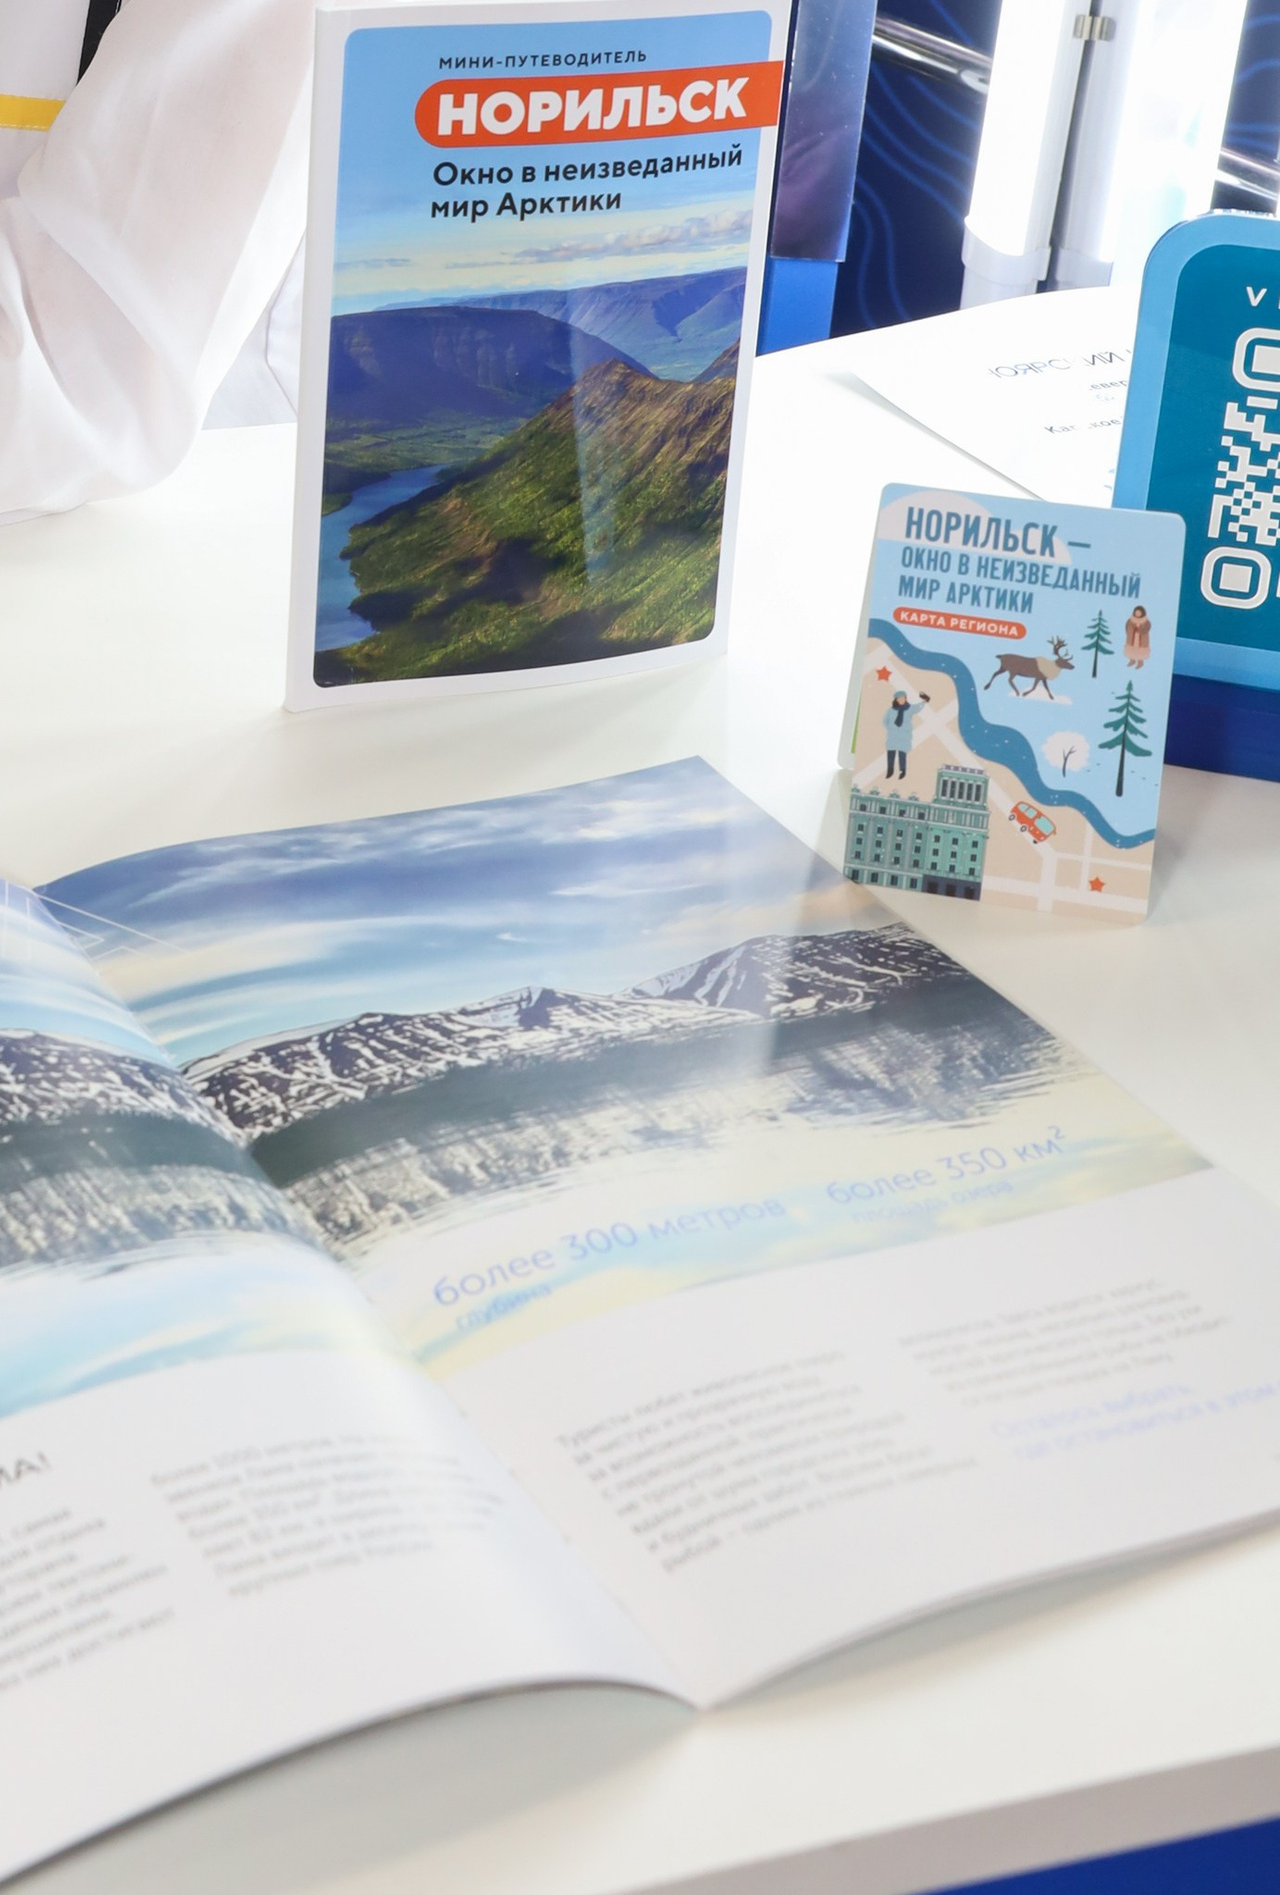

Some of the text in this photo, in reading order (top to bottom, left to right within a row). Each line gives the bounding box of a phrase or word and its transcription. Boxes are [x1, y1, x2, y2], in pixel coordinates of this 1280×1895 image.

[438, 50, 648, 70] МИНИ-ПУТЕВОДИТЕЛЬ
[437, 76, 750, 136] НОРИЛЬСК
[432, 143, 743, 187] Окно в неизведанный
[430, 190, 622, 224] мир Арктики
[904, 506, 1058, 559] НОРИЛЬСК
[897, 575, 1035, 615] МИР АРКТИКИ
[901, 546, 1142, 600] ОКНО В НЕИЗВЕДАННЫЙ
[899, 611, 1020, 638] КАРТА РЕГИОНА
[826, 1167, 937, 1205] более
[935, 1146, 1008, 1181] 350
[432, 1197, 787, 1306] более 300 метров
